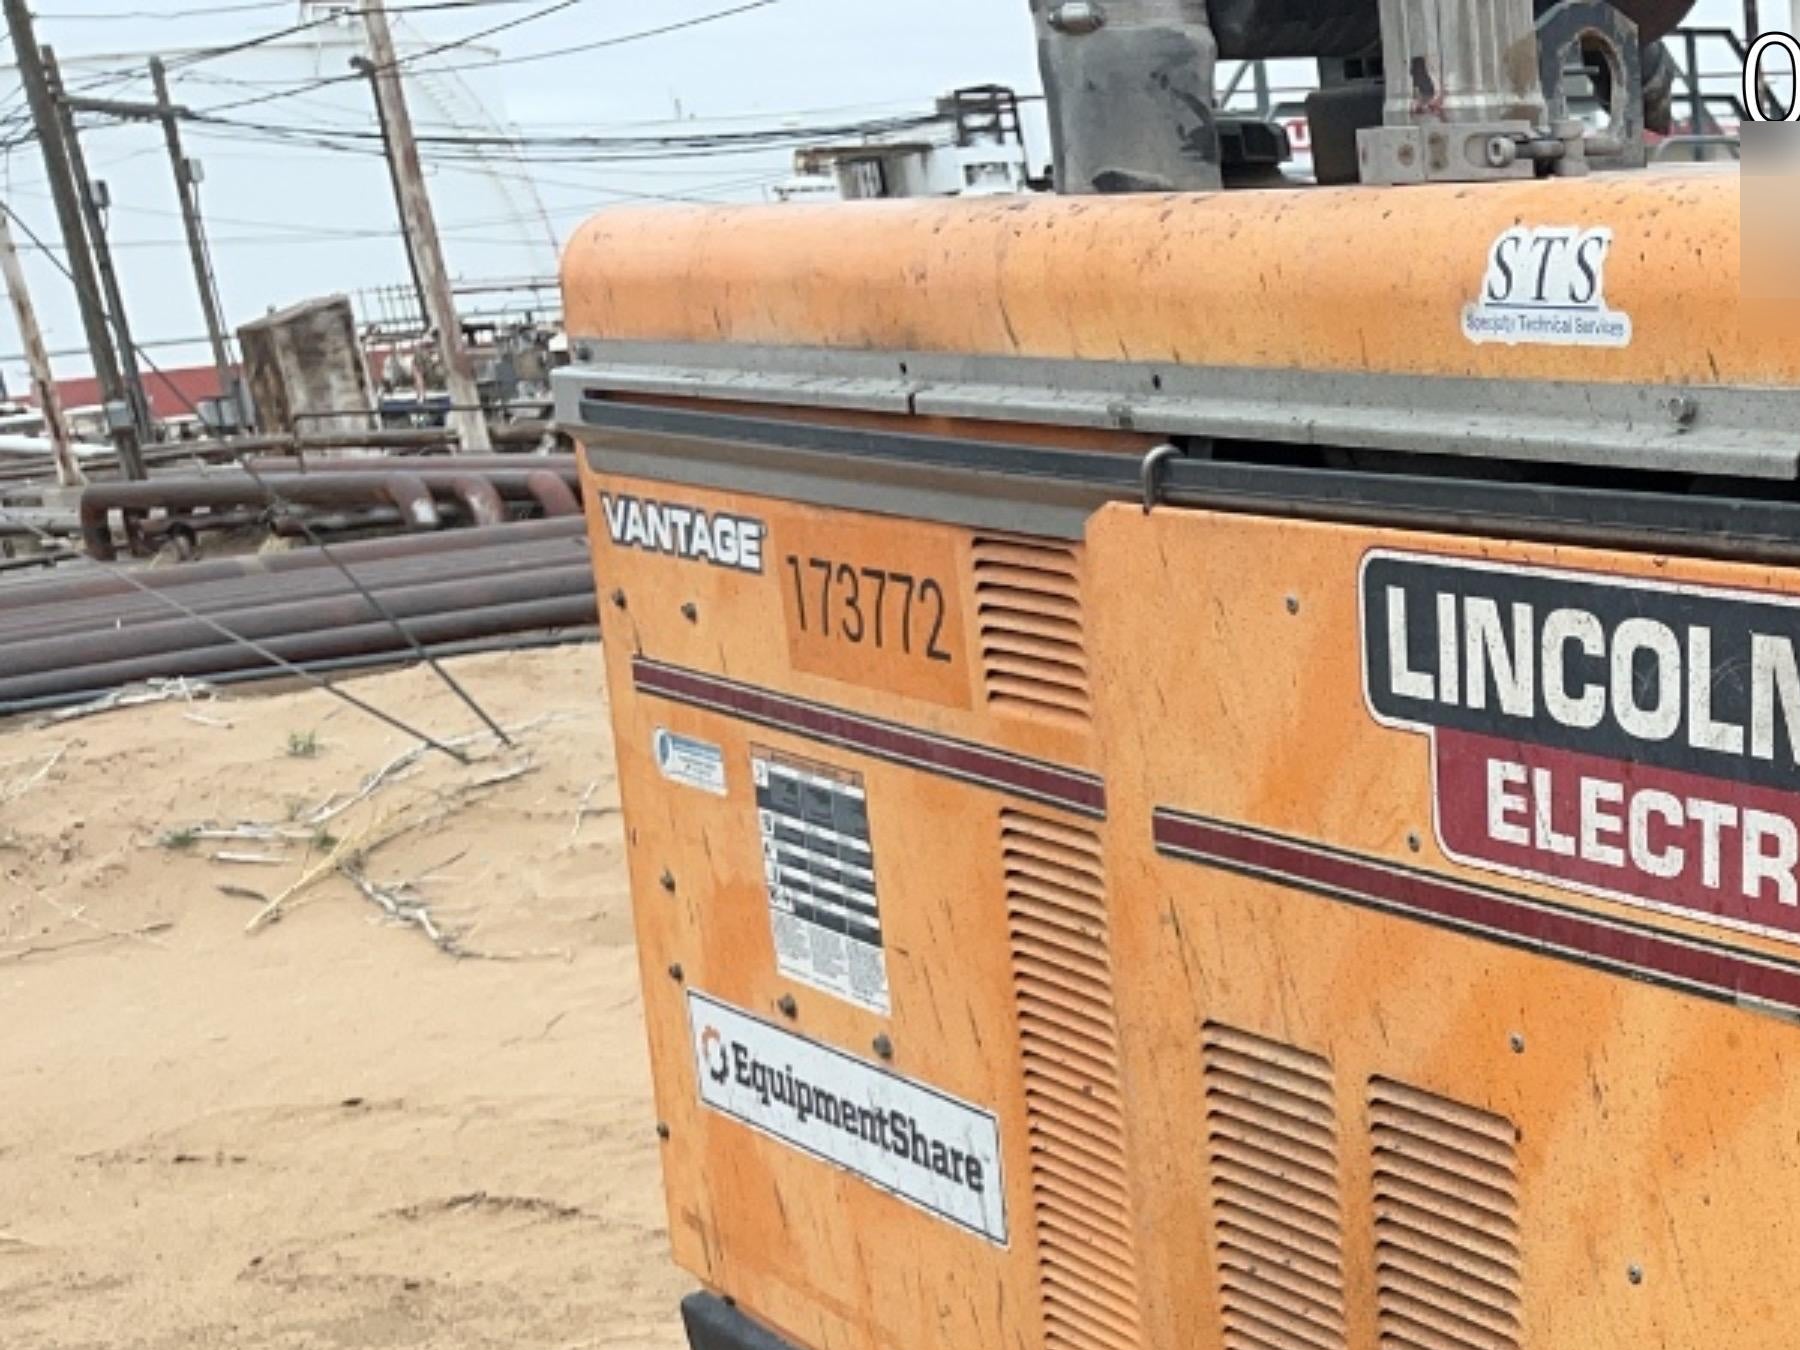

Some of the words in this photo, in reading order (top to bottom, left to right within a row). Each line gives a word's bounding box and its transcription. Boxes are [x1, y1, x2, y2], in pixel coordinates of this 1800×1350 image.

[1487, 235, 1604, 304] STS
[1518, 314, 1573, 335] Technical
[1575, 317, 1625, 337] Services
[602, 495, 764, 572] VANTAGE
[787, 554, 952, 663] 173772
[731, 1040, 985, 1194] EquipmentShare
